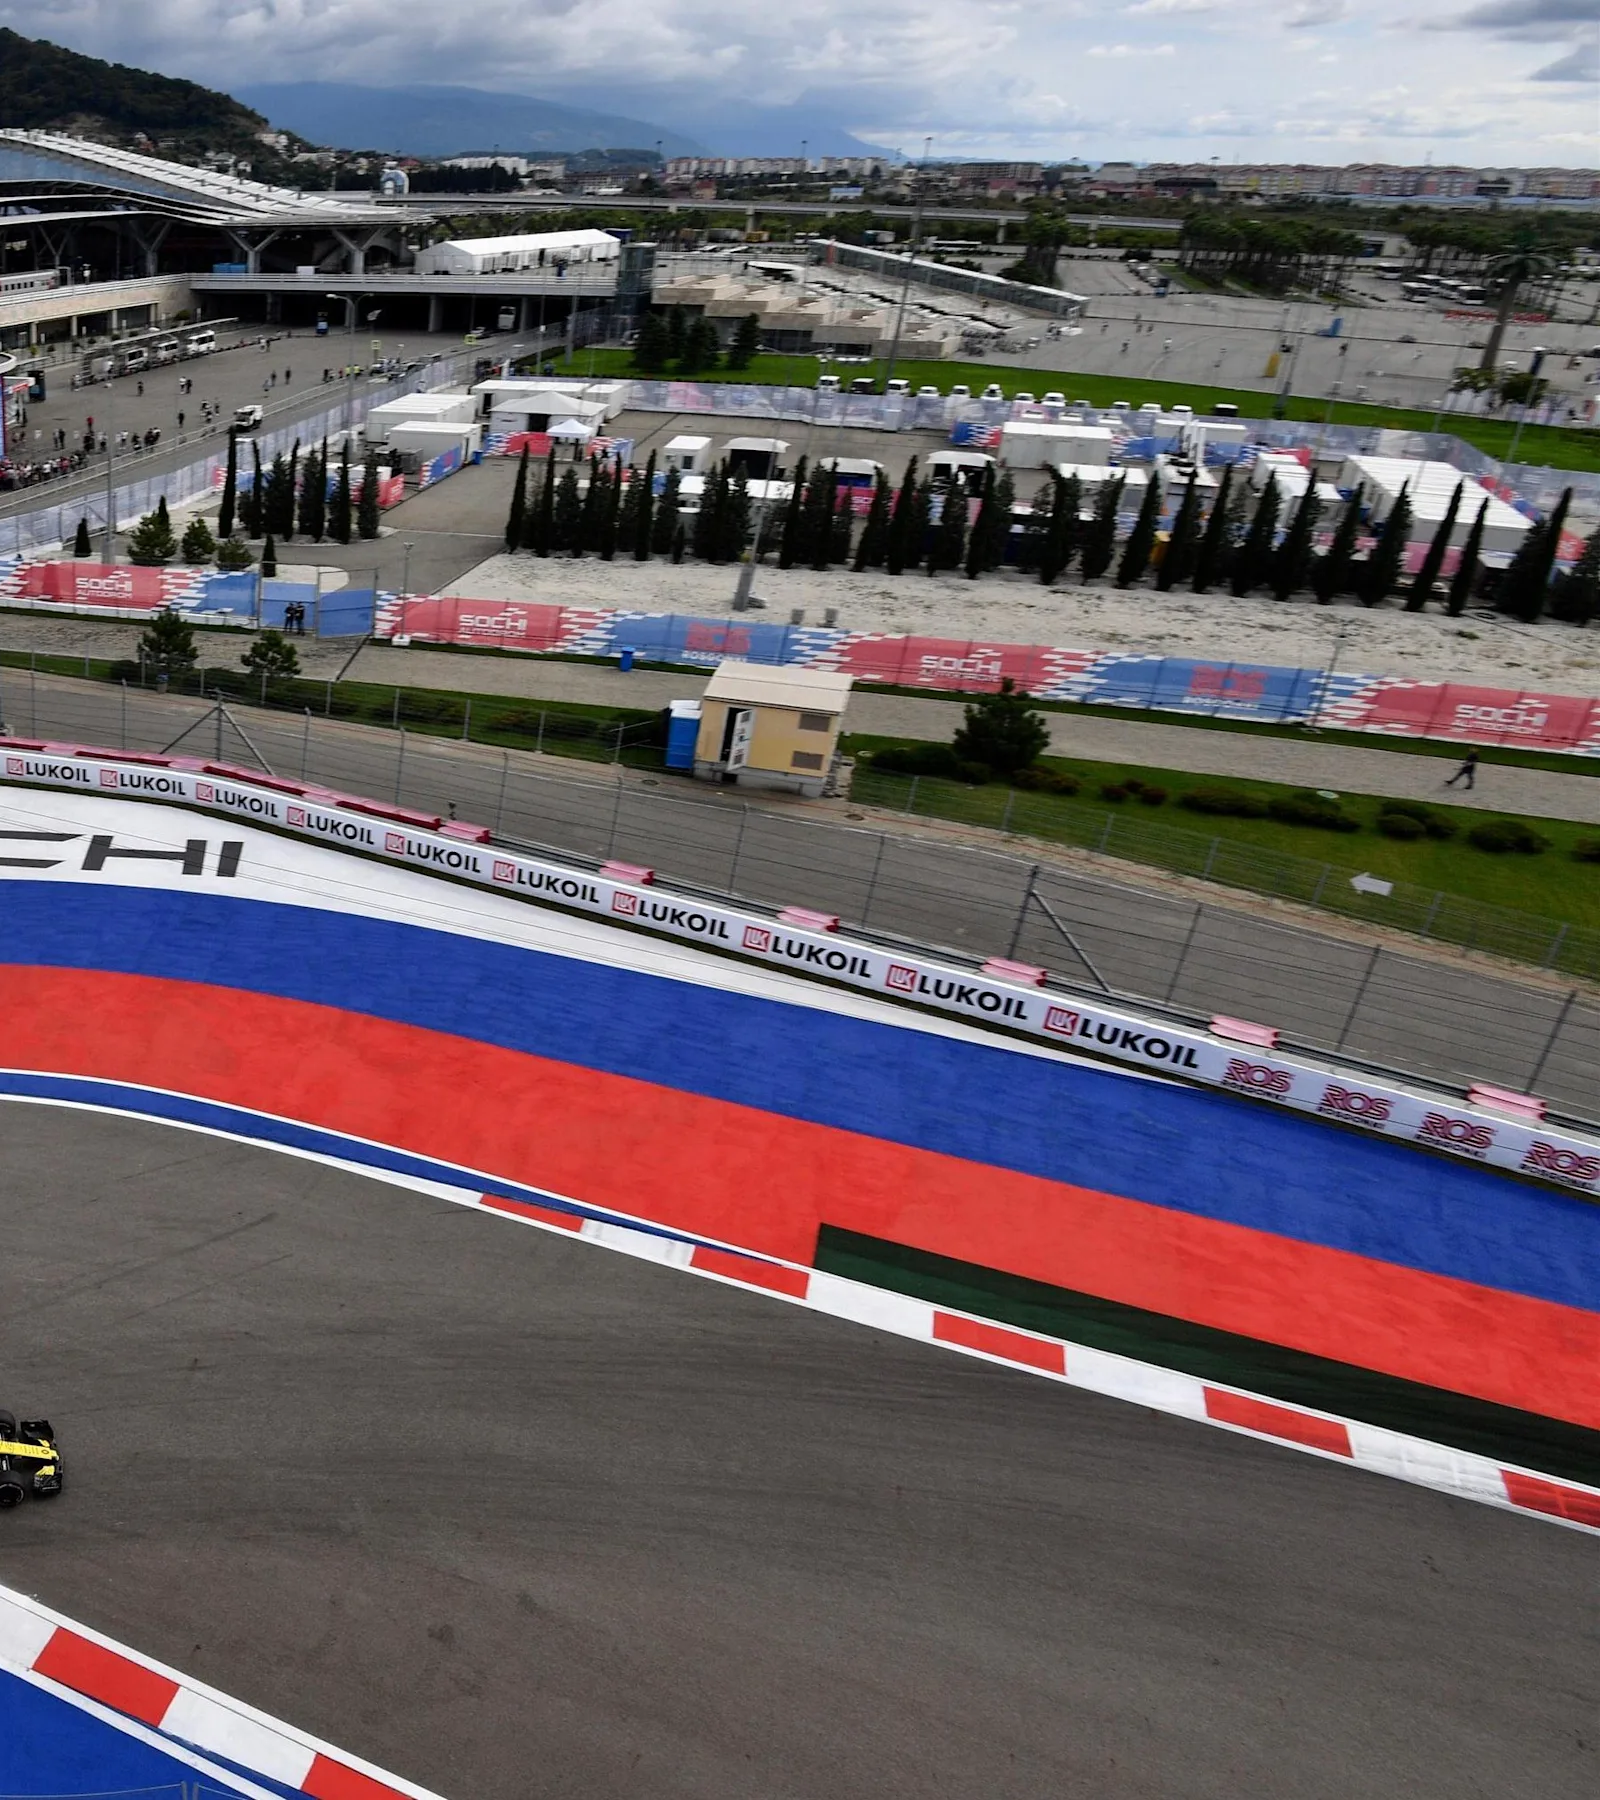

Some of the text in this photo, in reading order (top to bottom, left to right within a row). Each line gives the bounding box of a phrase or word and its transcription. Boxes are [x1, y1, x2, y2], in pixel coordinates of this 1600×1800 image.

[76, 578, 132, 592] SOCHI
[77, 589, 131, 599] AUTODROM
[459, 615, 527, 631] SOCHI
[459, 627, 525, 639] AUTODROM
[920, 669, 1000, 682] AUTODROM
[921, 655, 1002, 674] SOCHI
[1452, 718, 1542, 735] AUTODROM
[1456, 704, 1547, 726] SOCHI
[26, 762, 90, 782] LUKOIL
[120, 774, 187, 796] LUKOIL
[215, 789, 278, 818] LUKOIL
[306, 813, 374, 844] LUKOIL
[407, 840, 481, 873] LUKOIL
[517, 868, 599, 903] LUKOIL
[639, 900, 729, 939] LUKOIL
[771, 935, 871, 978] LUKOIL
[918, 975, 1028, 1020] LUKOIL
[1079, 1018, 1199, 1069] LUKOIL
[1225, 1057, 1291, 1093] ROS
[1222, 1079, 1287, 1103] ROSGONKI
[1322, 1083, 1390, 1121] ROS
[1316, 1105, 1384, 1131] ROSGONKI
[1423, 1111, 1493, 1149] ROS
[1414, 1133, 1487, 1159] ROSGONKI
[1528, 1140, 1600, 1181] ROS
